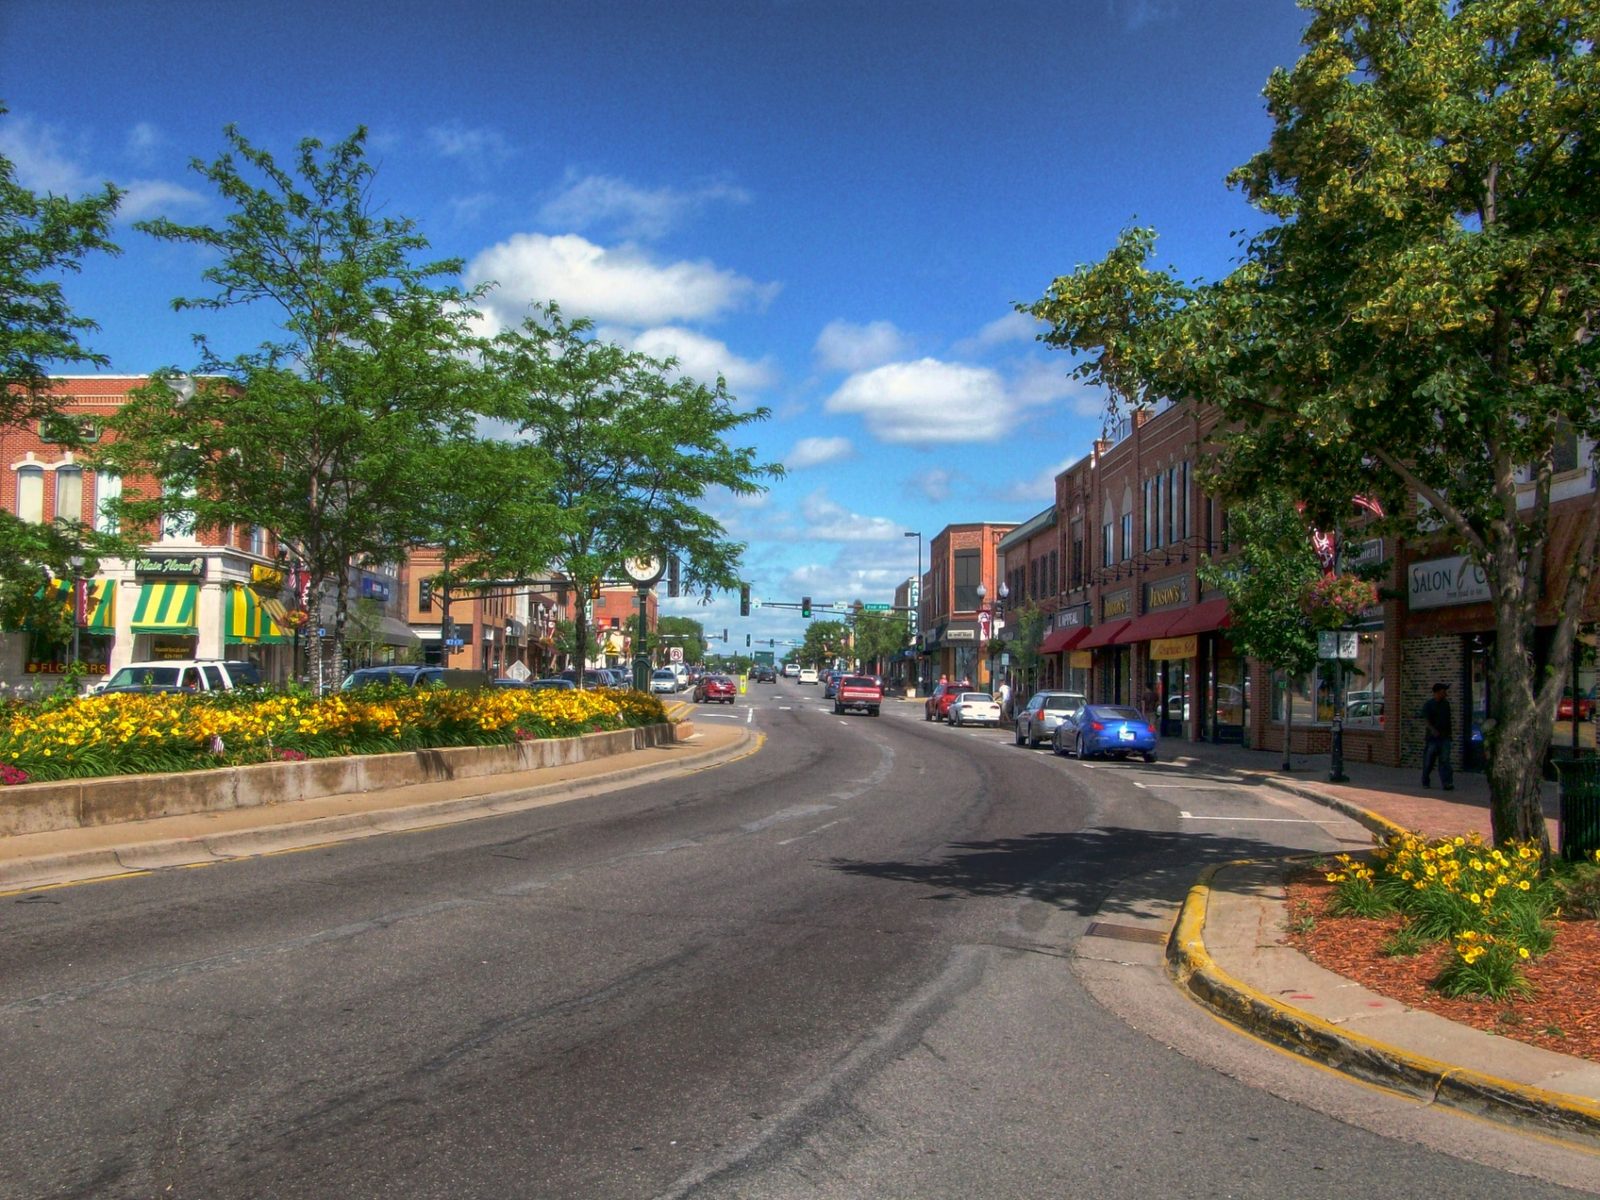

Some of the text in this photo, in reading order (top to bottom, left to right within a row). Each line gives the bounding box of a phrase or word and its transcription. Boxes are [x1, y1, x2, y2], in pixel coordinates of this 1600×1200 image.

[137, 558, 195, 573] Main Floral
[1412, 567, 1451, 593] SALON
[1148, 585, 1180, 608] JENSON'S
